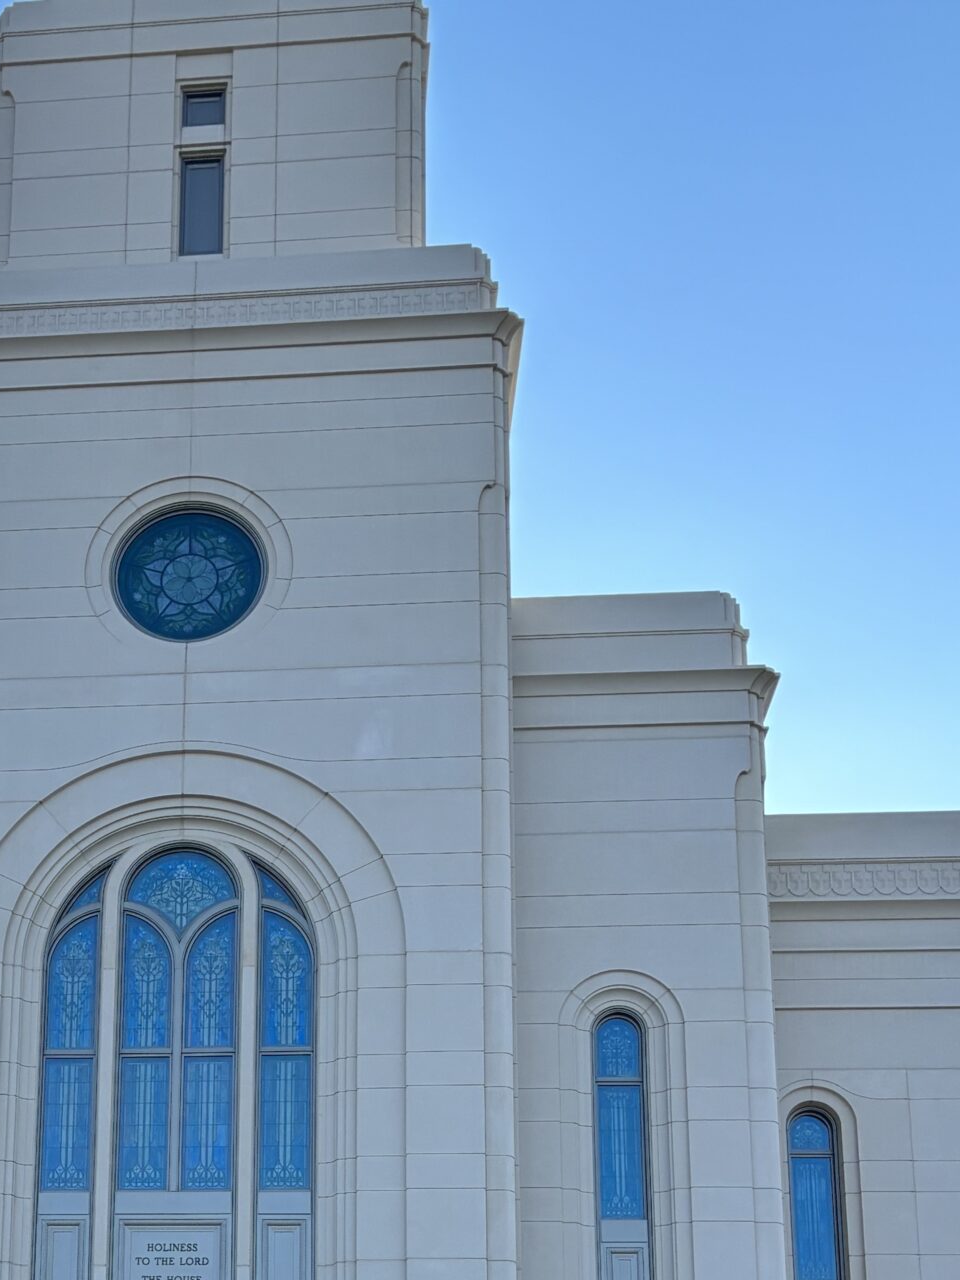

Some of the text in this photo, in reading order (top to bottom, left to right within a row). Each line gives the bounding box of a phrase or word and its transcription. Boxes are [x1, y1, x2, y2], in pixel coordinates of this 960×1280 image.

[147, 1243, 198, 1252] HOLINESS
[135, 1257, 209, 1266] TO THE LORD
